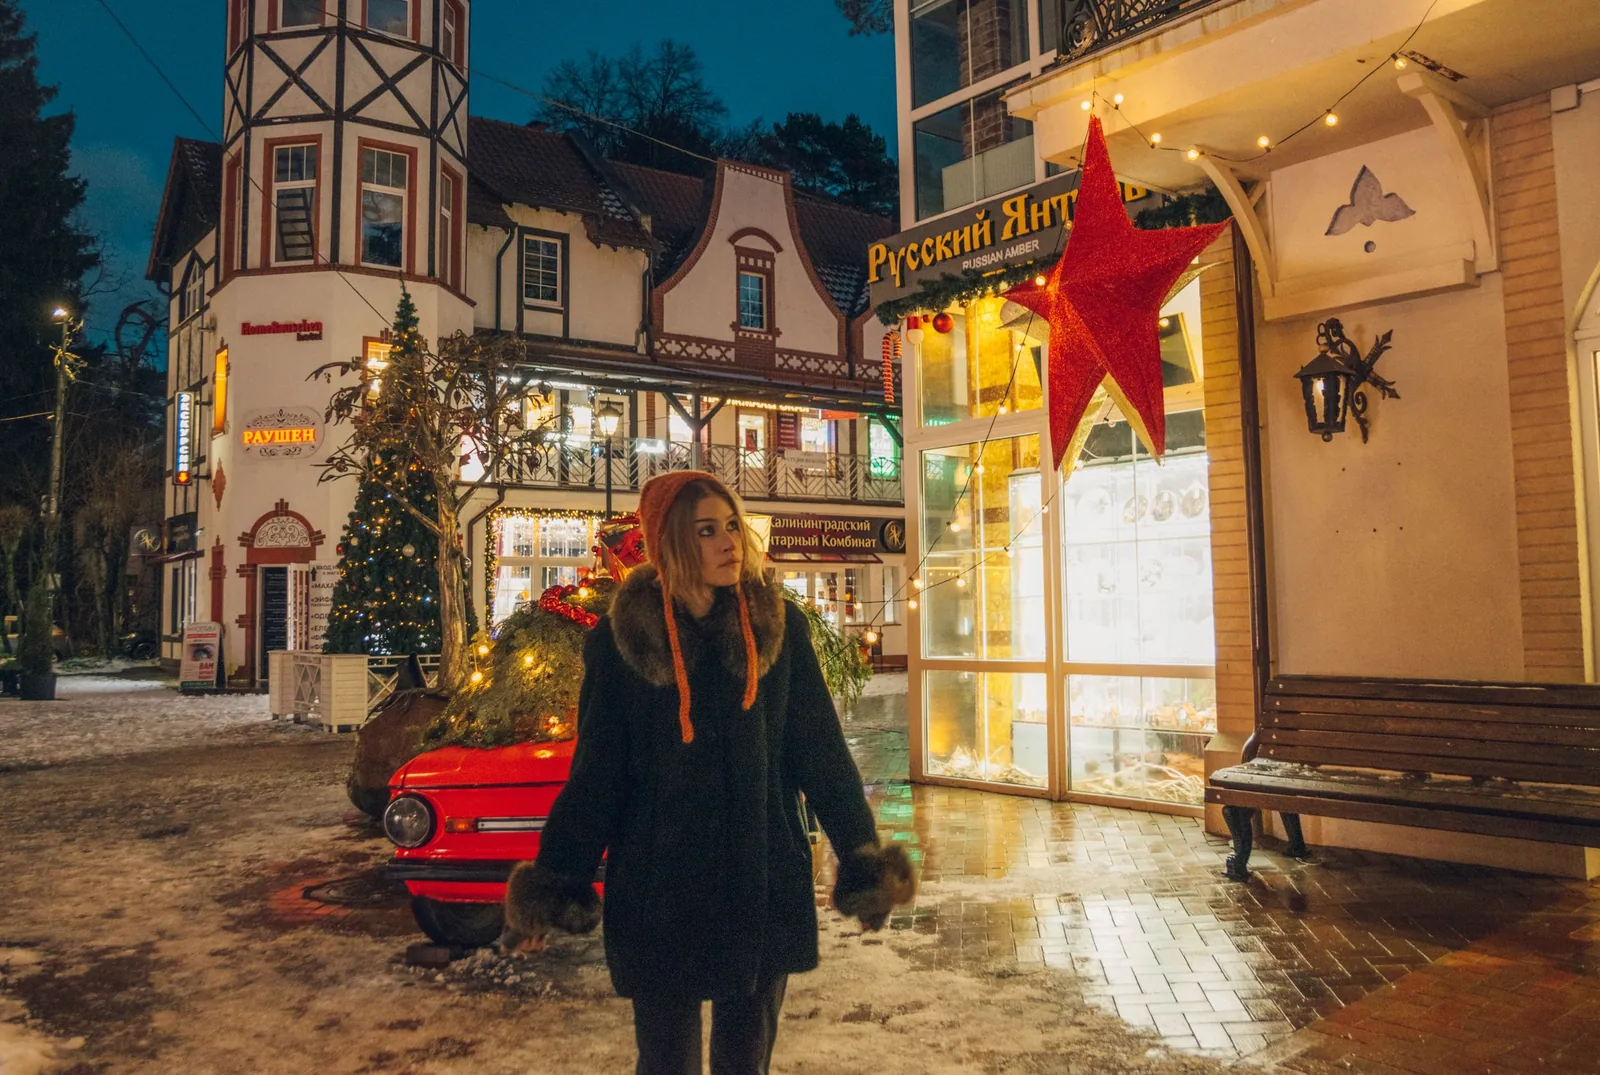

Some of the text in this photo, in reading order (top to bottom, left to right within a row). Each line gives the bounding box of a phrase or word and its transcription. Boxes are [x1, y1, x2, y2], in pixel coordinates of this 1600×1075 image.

[867, 182, 1147, 288] Русский Янть
[962, 250, 1004, 271] RUSSIAN
[1004, 239, 1041, 260] AMBER
[242, 428, 316, 444] РАУШЕН
[769, 534, 877, 549] нтарный Комбинат
